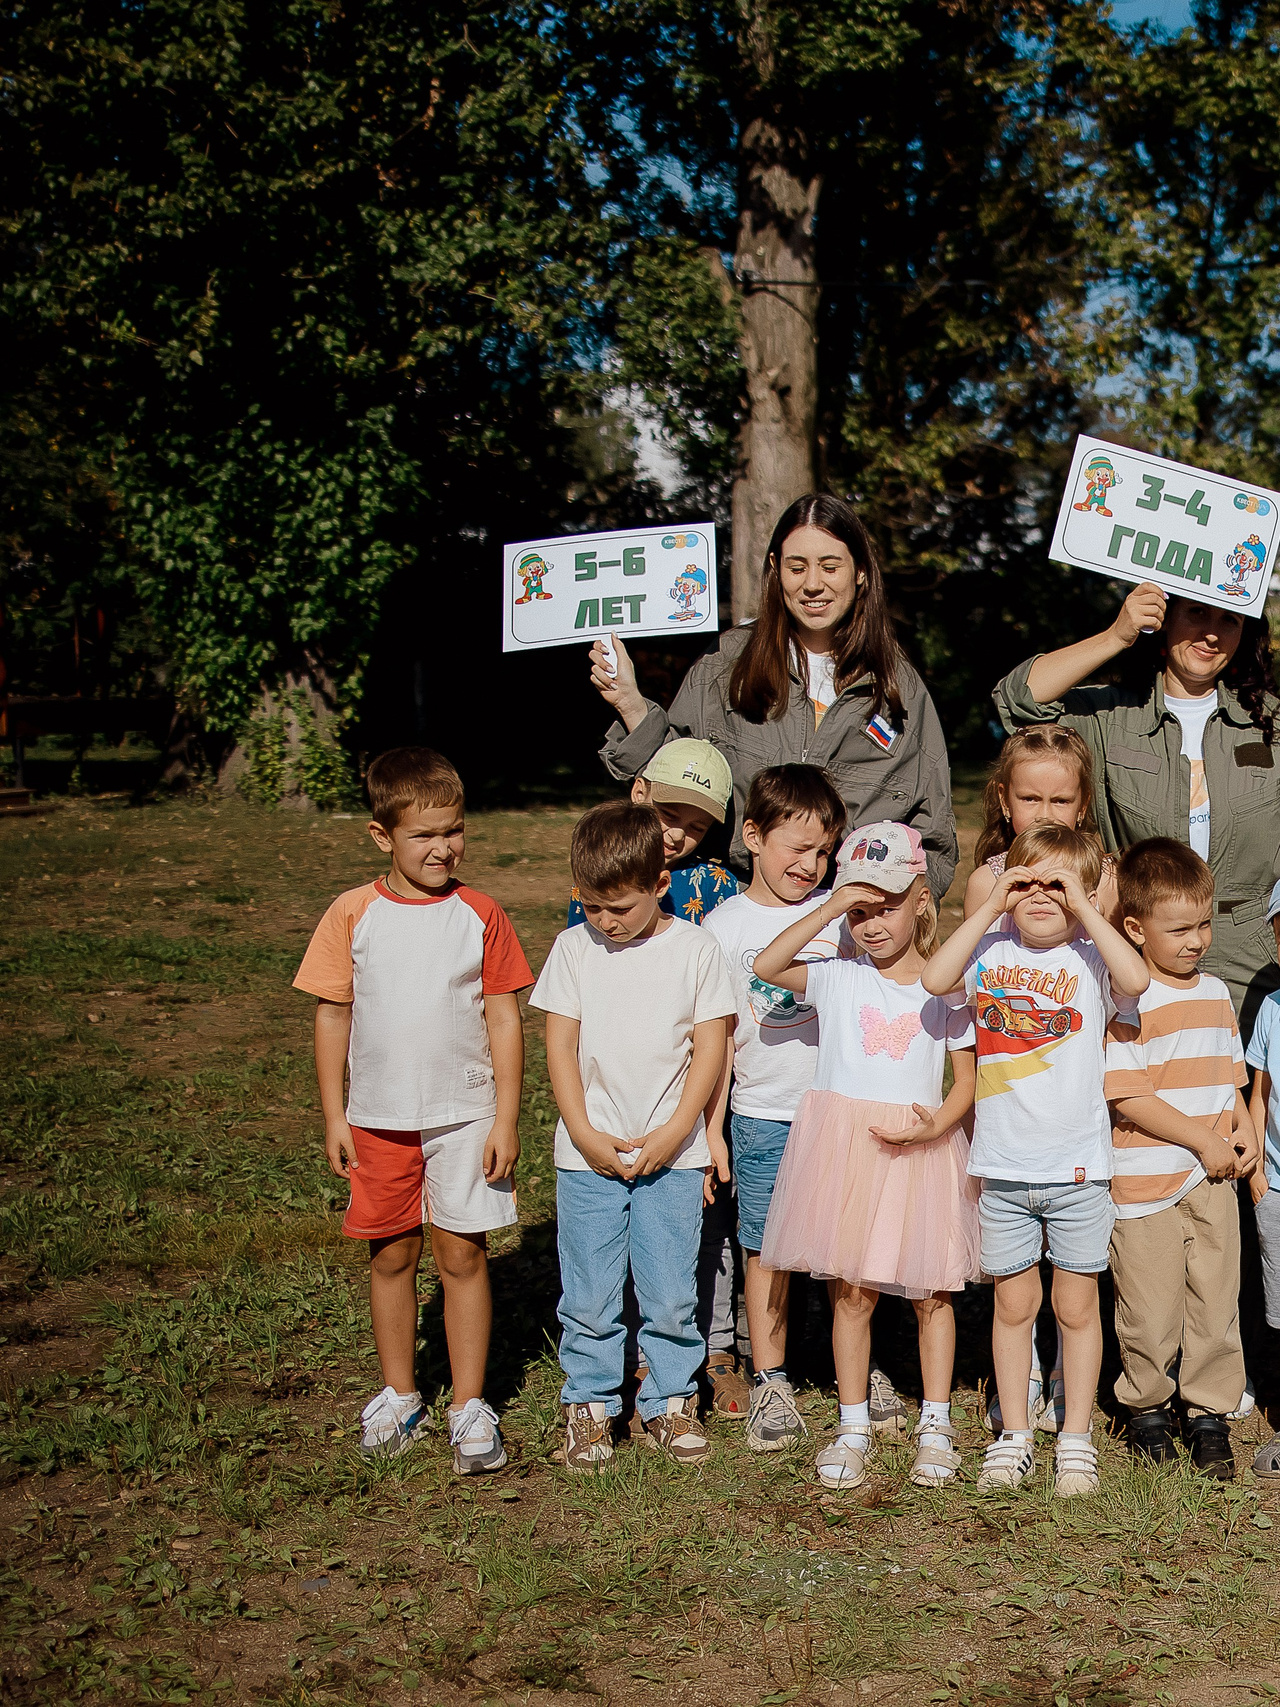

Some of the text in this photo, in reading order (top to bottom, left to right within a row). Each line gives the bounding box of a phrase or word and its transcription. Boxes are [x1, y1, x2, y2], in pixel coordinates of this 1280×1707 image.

[1107, 524, 1213, 586] ГОДА
[574, 594, 646, 629] ЛЕТ
[682, 771, 711, 789] FILA
[578, 1407, 587, 1418] 03
